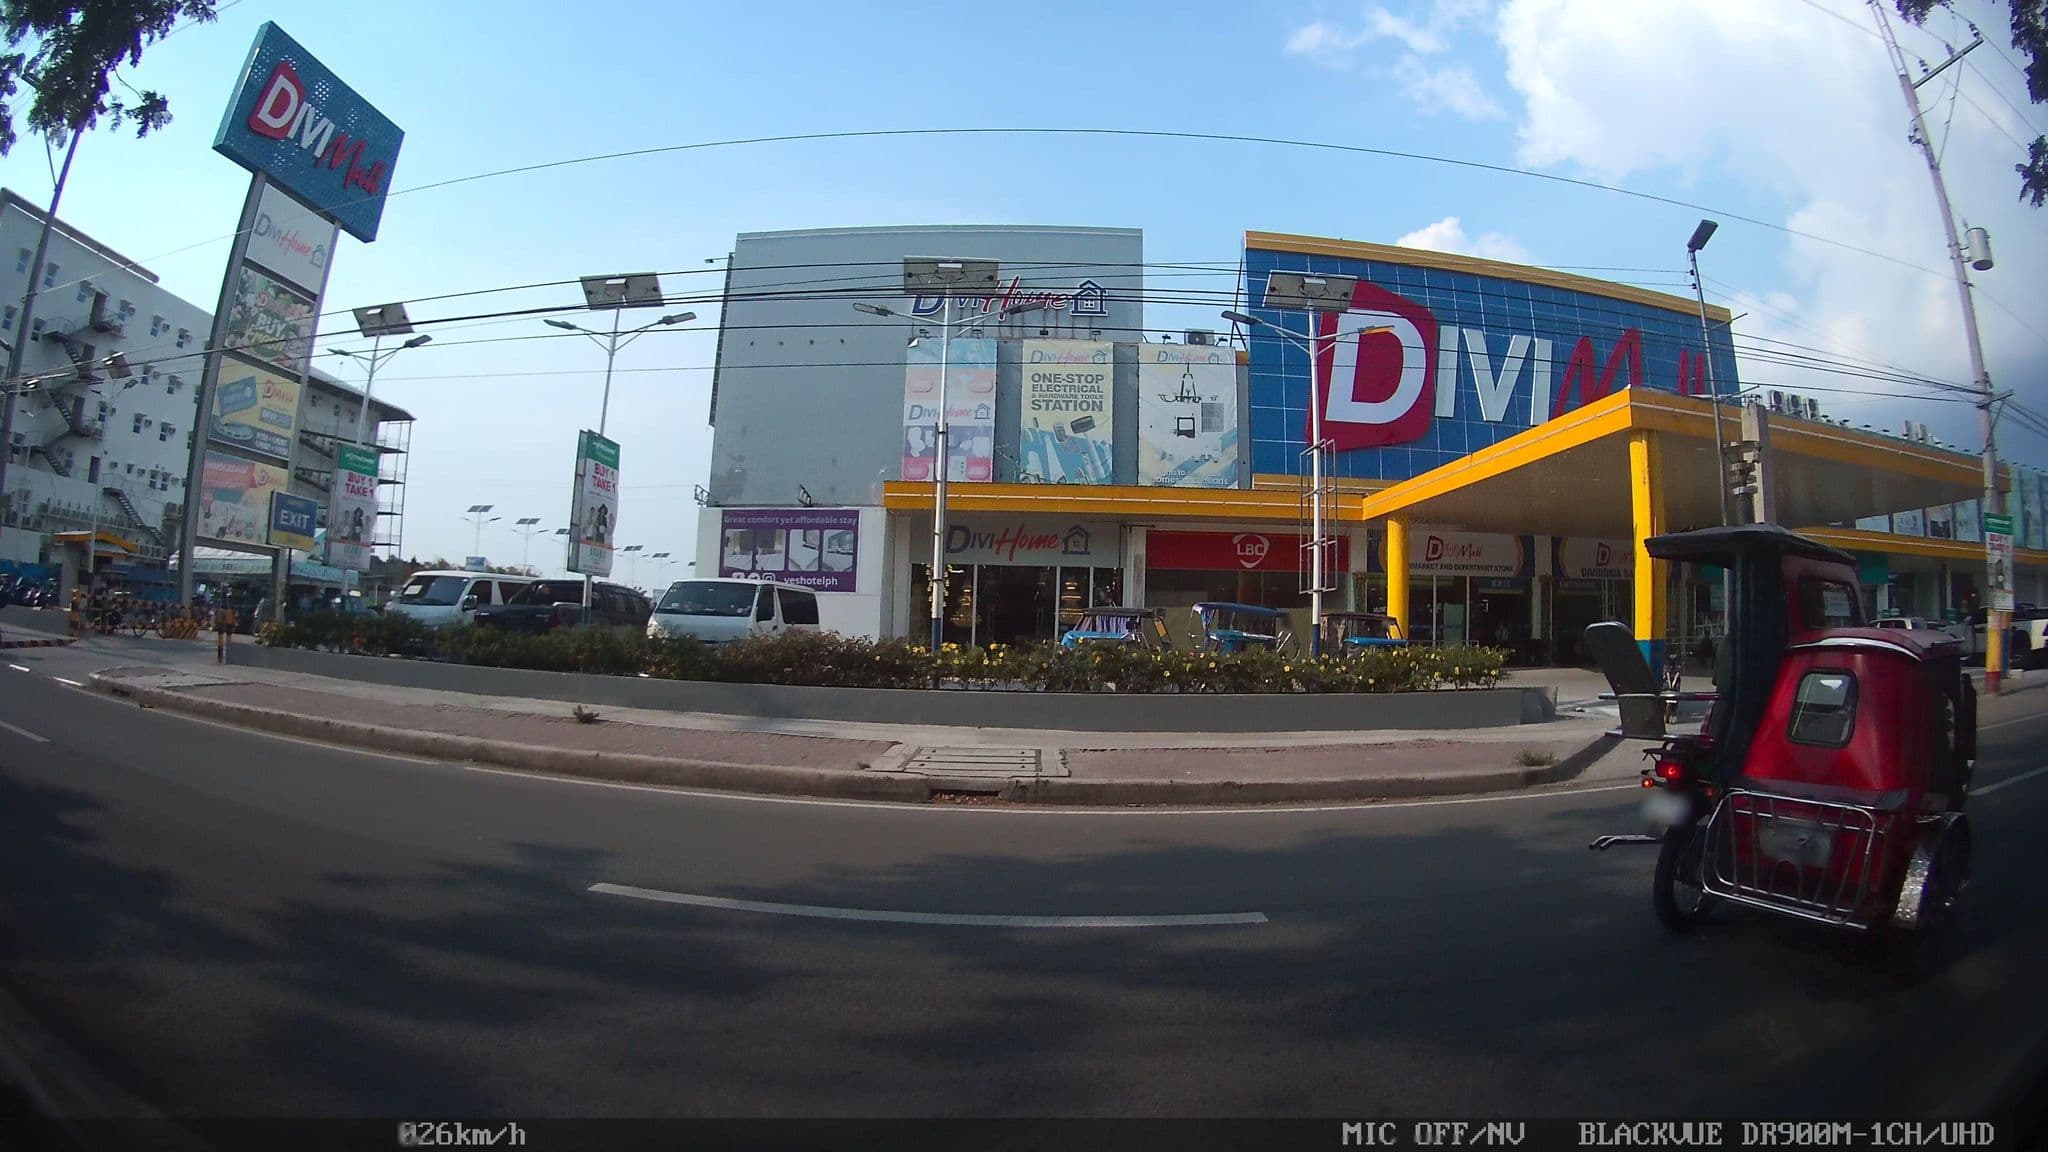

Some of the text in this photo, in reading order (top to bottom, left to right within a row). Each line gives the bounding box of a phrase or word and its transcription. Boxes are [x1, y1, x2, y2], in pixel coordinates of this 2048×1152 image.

[1031, 373, 1105, 384] ONE-STOP
[1031, 384, 1104, 393] ELECTRICAL
[1031, 399, 1104, 412] STATION
[280, 509, 310, 530] EXIT
[795, 516, 837, 524] affordable
[839, 517, 857, 526] stay
[1237, 543, 1265, 556] LBC
[784, 575, 838, 588] yeshotelph
